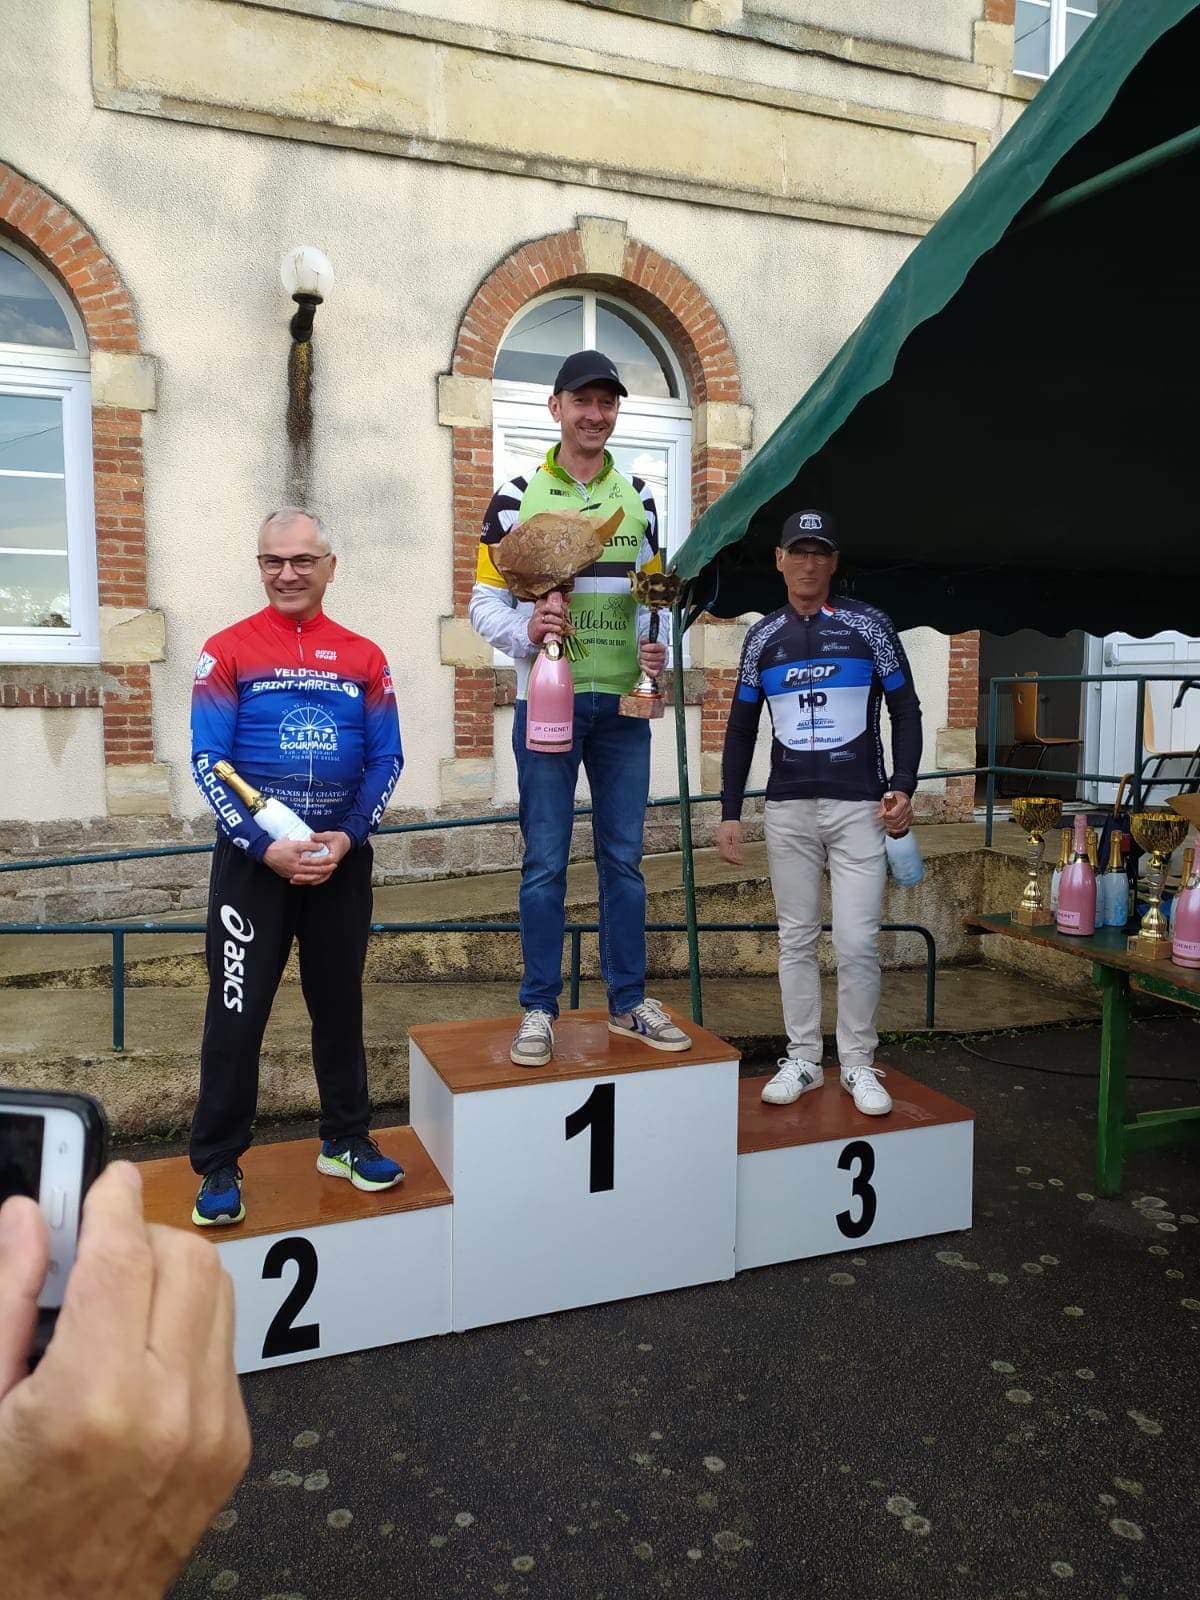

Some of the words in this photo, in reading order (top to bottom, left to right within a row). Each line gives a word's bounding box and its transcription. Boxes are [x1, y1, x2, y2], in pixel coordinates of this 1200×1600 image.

[252, 679, 344, 692] SAINT-MARCEL
[280, 741, 338, 751] GOURMANDE
[564, 1082, 616, 1194] 1
[835, 1140, 878, 1239] 3
[261, 1236, 320, 1359] 2
